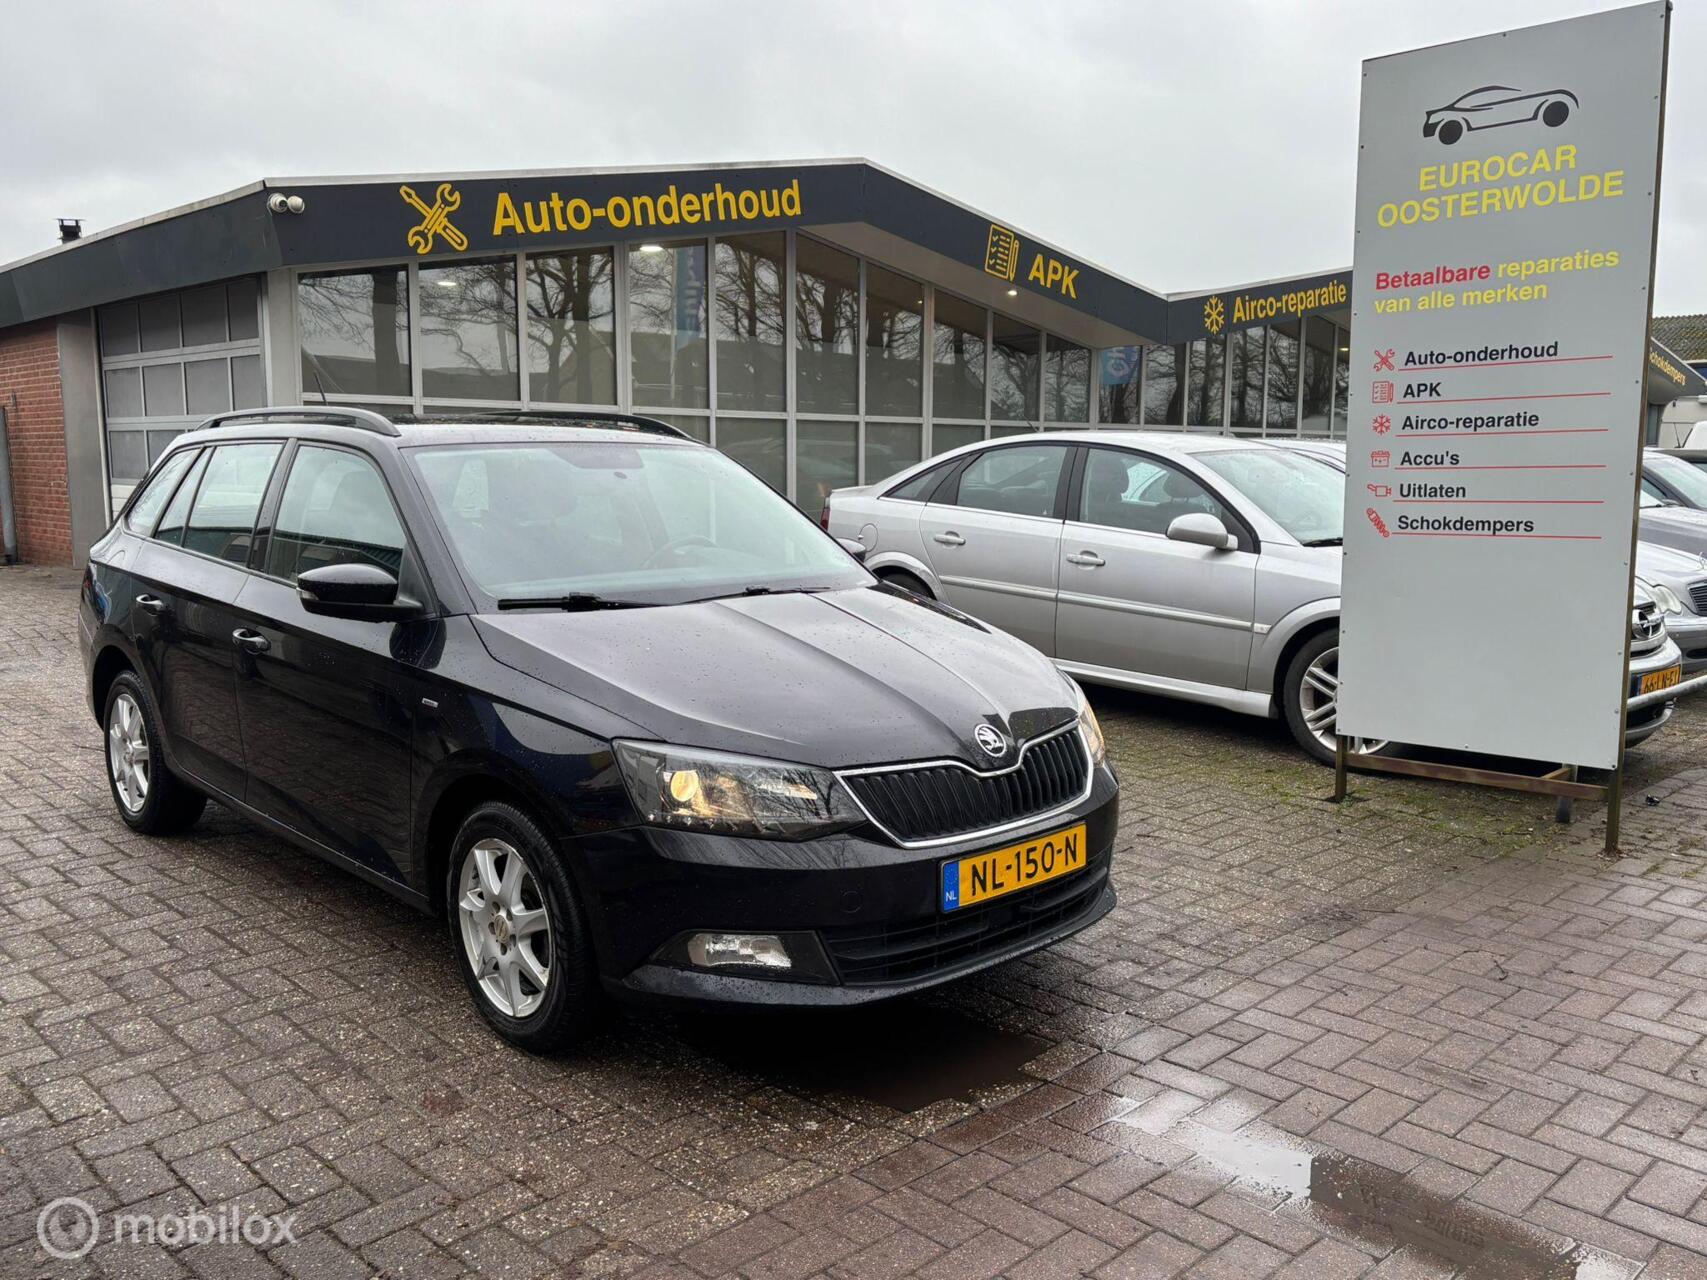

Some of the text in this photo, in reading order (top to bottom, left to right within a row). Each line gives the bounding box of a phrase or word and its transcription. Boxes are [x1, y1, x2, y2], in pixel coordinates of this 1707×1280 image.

[1418, 144, 1577, 192] EUROCAR
[492, 179, 802, 236] Auto-onderhoud
[1377, 169, 1625, 228] OOSTERWOLDE
[1028, 254, 1080, 299] APK
[1375, 249, 1620, 290] Betaalbare reparaties
[1232, 279, 1347, 323] Airco-reparatie
[1374, 281, 1548, 314] van alle merken
[1404, 341, 1559, 366] Auto-onderhoud
[1649, 347, 1686, 386] chokdempers
[1402, 382, 1442, 399] APK
[1401, 411, 1540, 432] Airco-reparatie
[1400, 450, 1460, 466] Accu's
[1399, 483, 1466, 498] Uitlaten
[1398, 515, 1535, 536] Schokdempers
[945, 832, 1078, 902] NL NL-150-N
